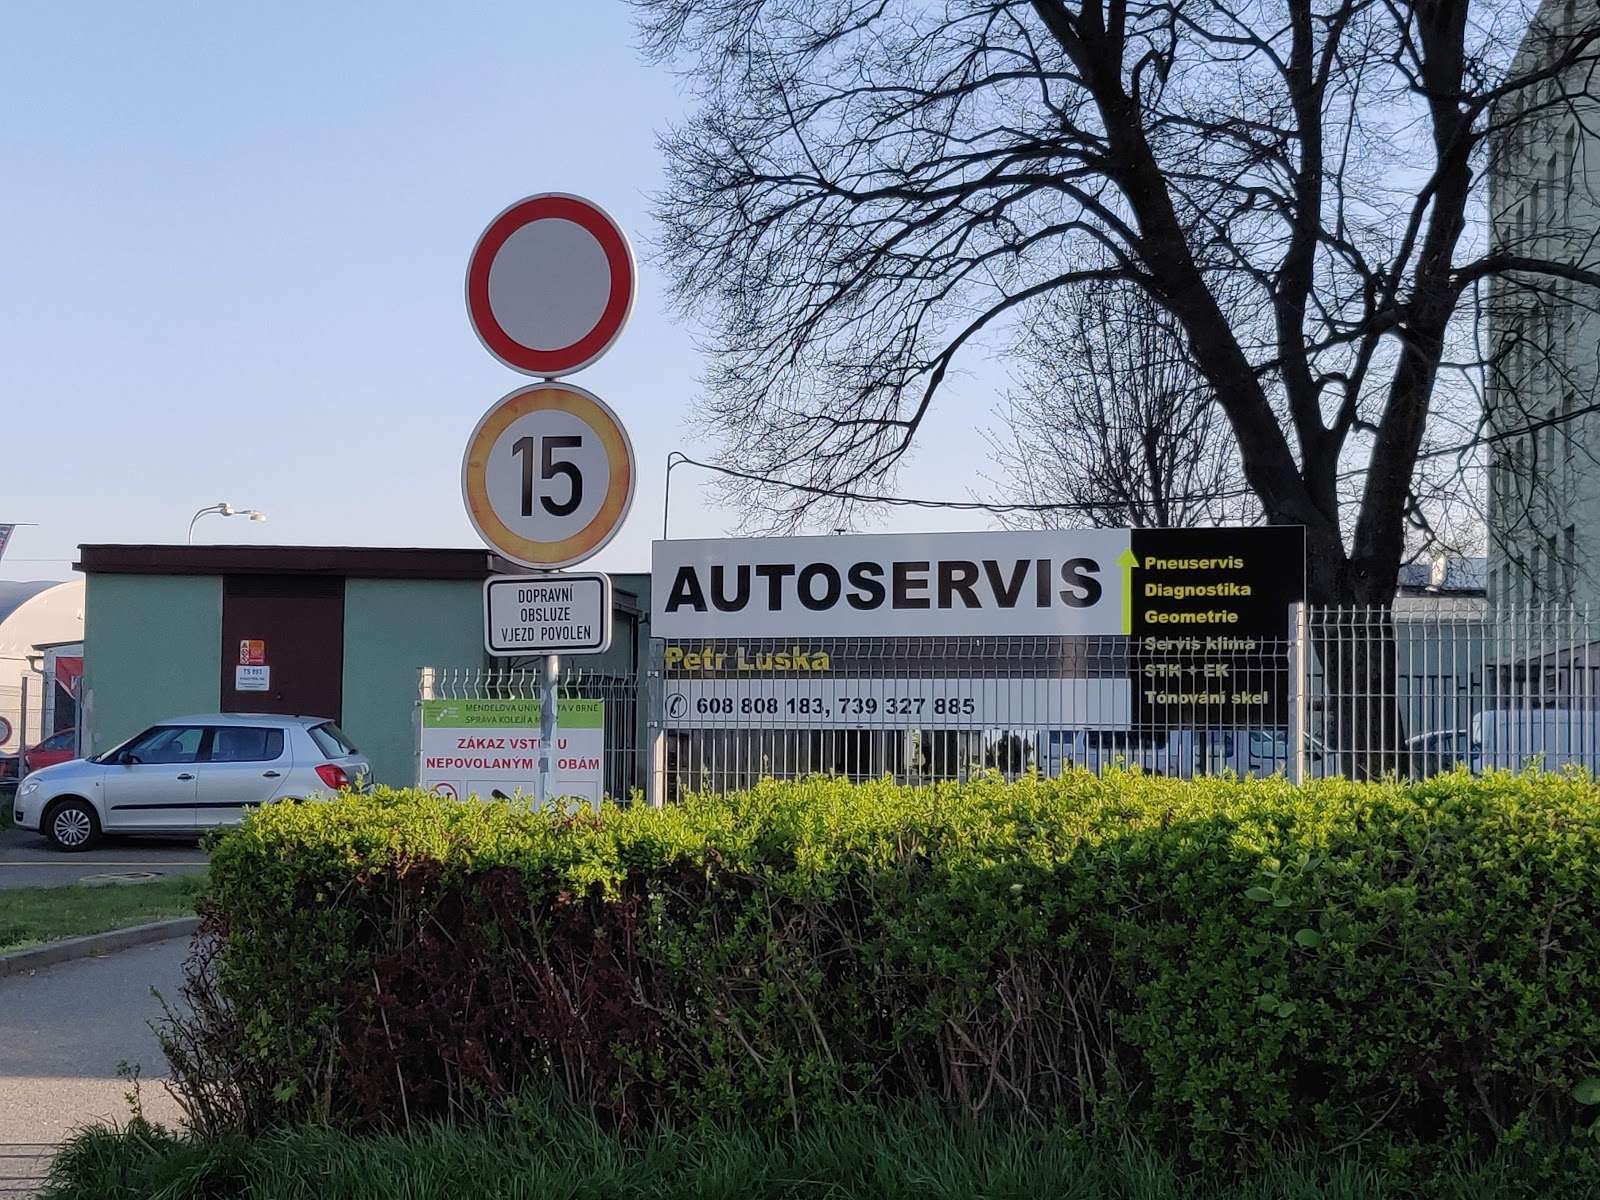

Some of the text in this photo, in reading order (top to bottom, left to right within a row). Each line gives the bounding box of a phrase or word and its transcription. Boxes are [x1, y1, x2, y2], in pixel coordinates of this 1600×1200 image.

[511, 436, 583, 517] 15
[1144, 556, 1244, 570] Pneuservis
[665, 557, 1103, 612] AUTOSERVIS
[1144, 583, 1252, 600] Diagnostika
[518, 584, 574, 603] DOPRAVNÍ
[520, 607, 571, 622] OBSLUZE
[1144, 610, 1239, 624] Geometrie
[501, 625, 591, 642] VJEZD POVOLEN
[1144, 636, 1256, 651] Servis klima
[666, 646, 830, 671] Petr Luska
[1144, 663, 1181, 677] STK
[1203, 664, 1229, 677] EK
[1144, 690, 1268, 705] Tónování skel
[696, 697, 975, 717] 608 808 183, 739 327 885
[457, 736, 505, 750] ZÁKAZ
[426, 756, 533, 769] NEPOVOLANÝM
